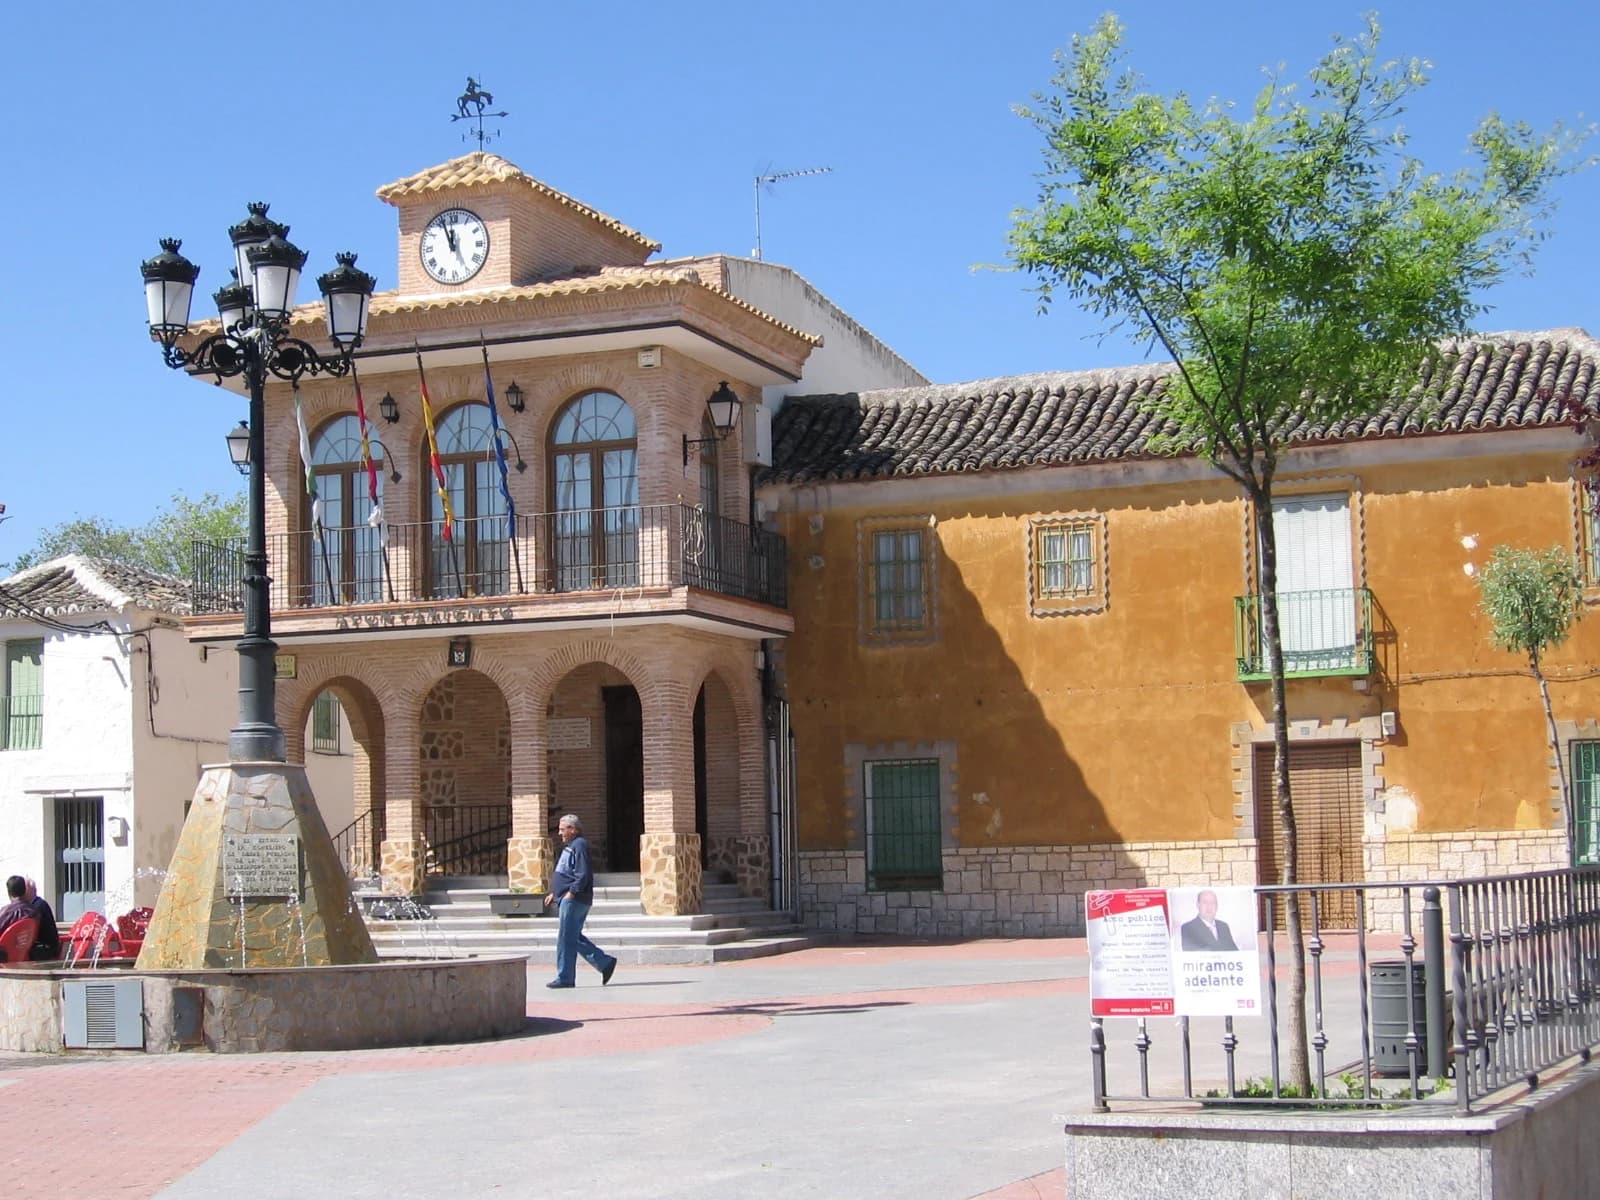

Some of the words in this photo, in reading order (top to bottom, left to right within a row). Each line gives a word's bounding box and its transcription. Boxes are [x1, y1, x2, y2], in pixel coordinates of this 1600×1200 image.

[336, 607, 513, 629] AYUNTAMIENTO
[1182, 961, 1244, 972] miramos
[1184, 974, 1245, 987] adelante
